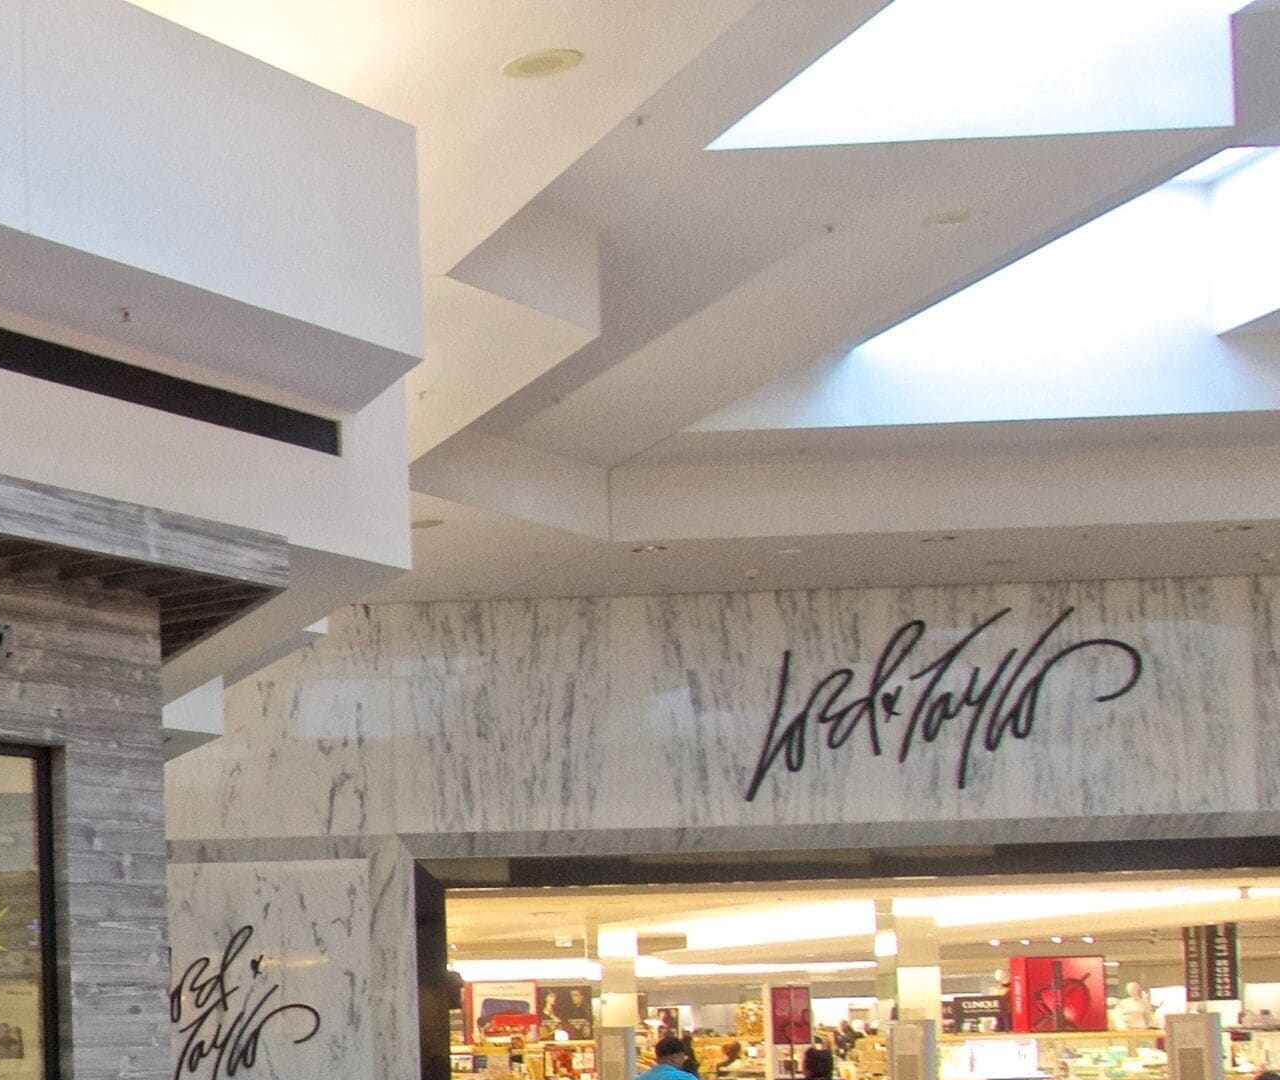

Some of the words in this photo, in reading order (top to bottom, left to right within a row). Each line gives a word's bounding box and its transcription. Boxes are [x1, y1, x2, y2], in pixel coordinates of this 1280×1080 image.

[1214, 937, 1229, 957] LAB
[168, 924, 254, 1024] ord
[1214, 959, 1232, 997] DESIGN
